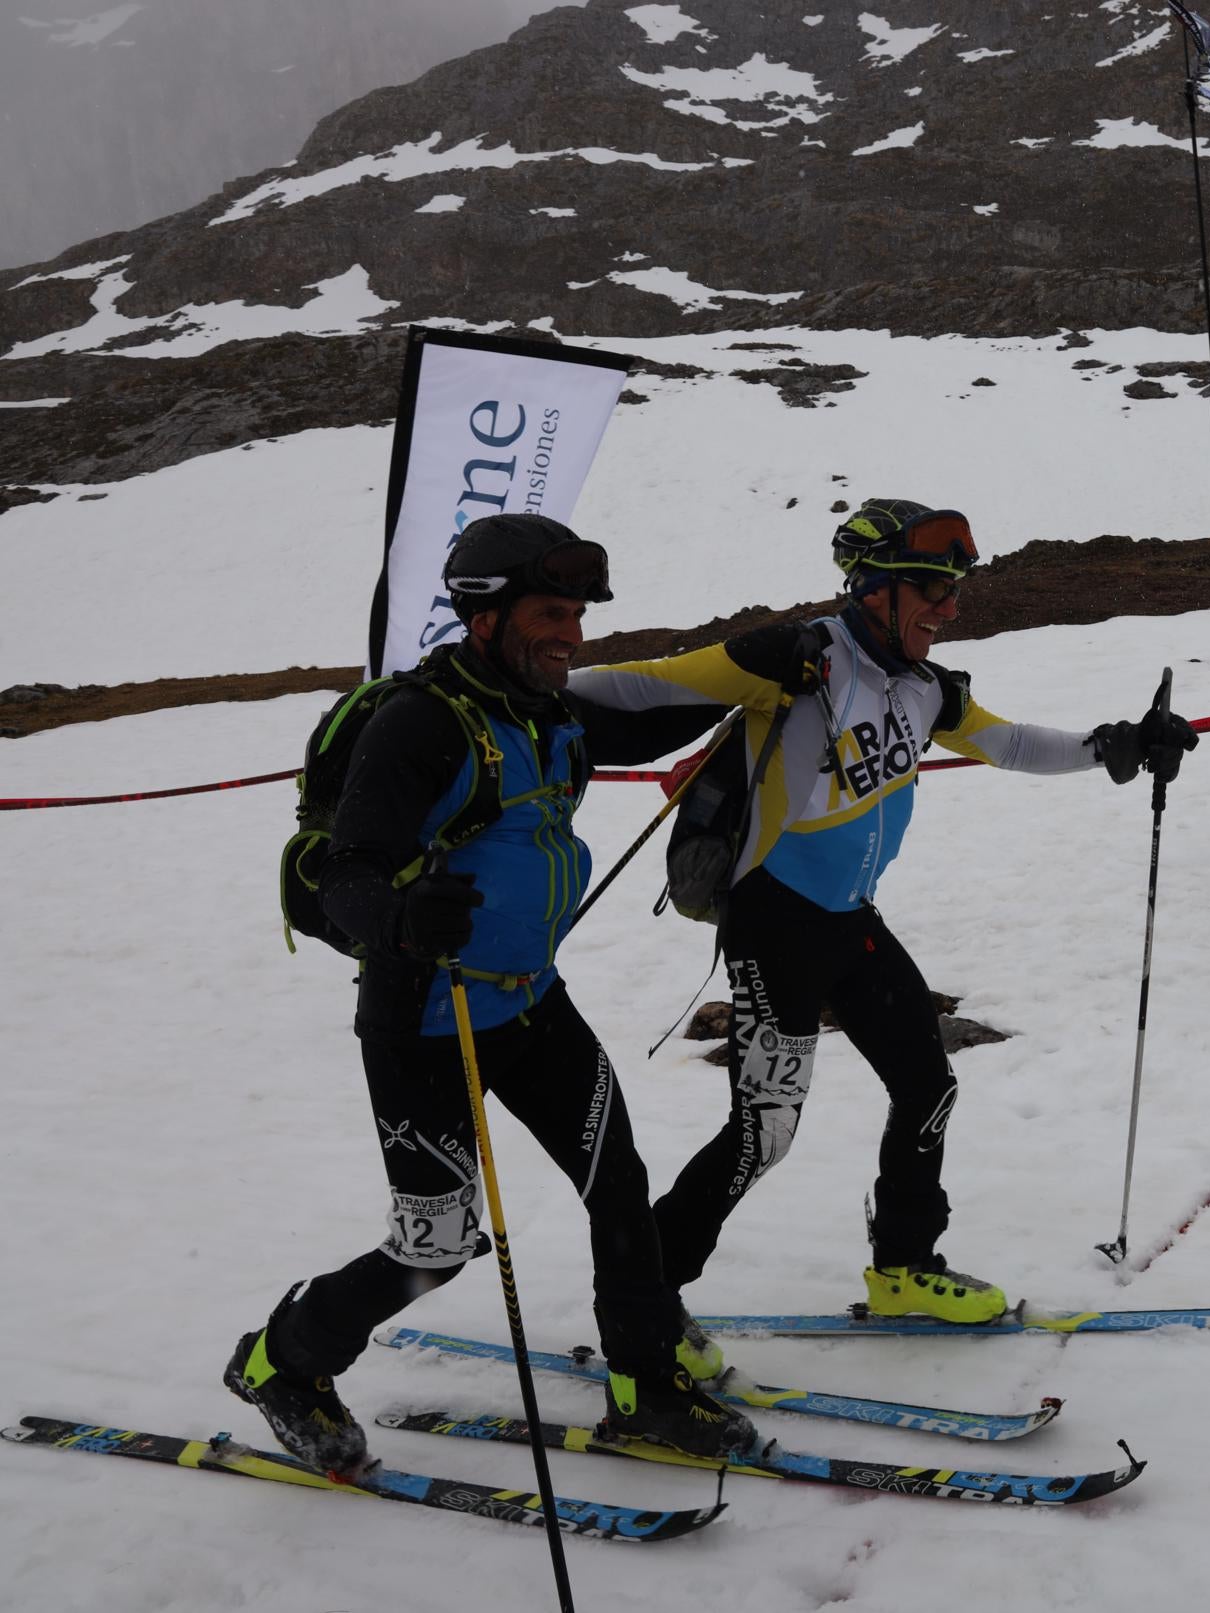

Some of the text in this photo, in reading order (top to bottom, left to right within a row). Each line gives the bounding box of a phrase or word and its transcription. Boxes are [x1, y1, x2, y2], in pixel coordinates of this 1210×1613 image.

[420, 400, 526, 649] sne
[766, 1055, 801, 1086] 12
[394, 1206, 479, 1248] 12 A
[411, 1207, 447, 1217] REGIL
